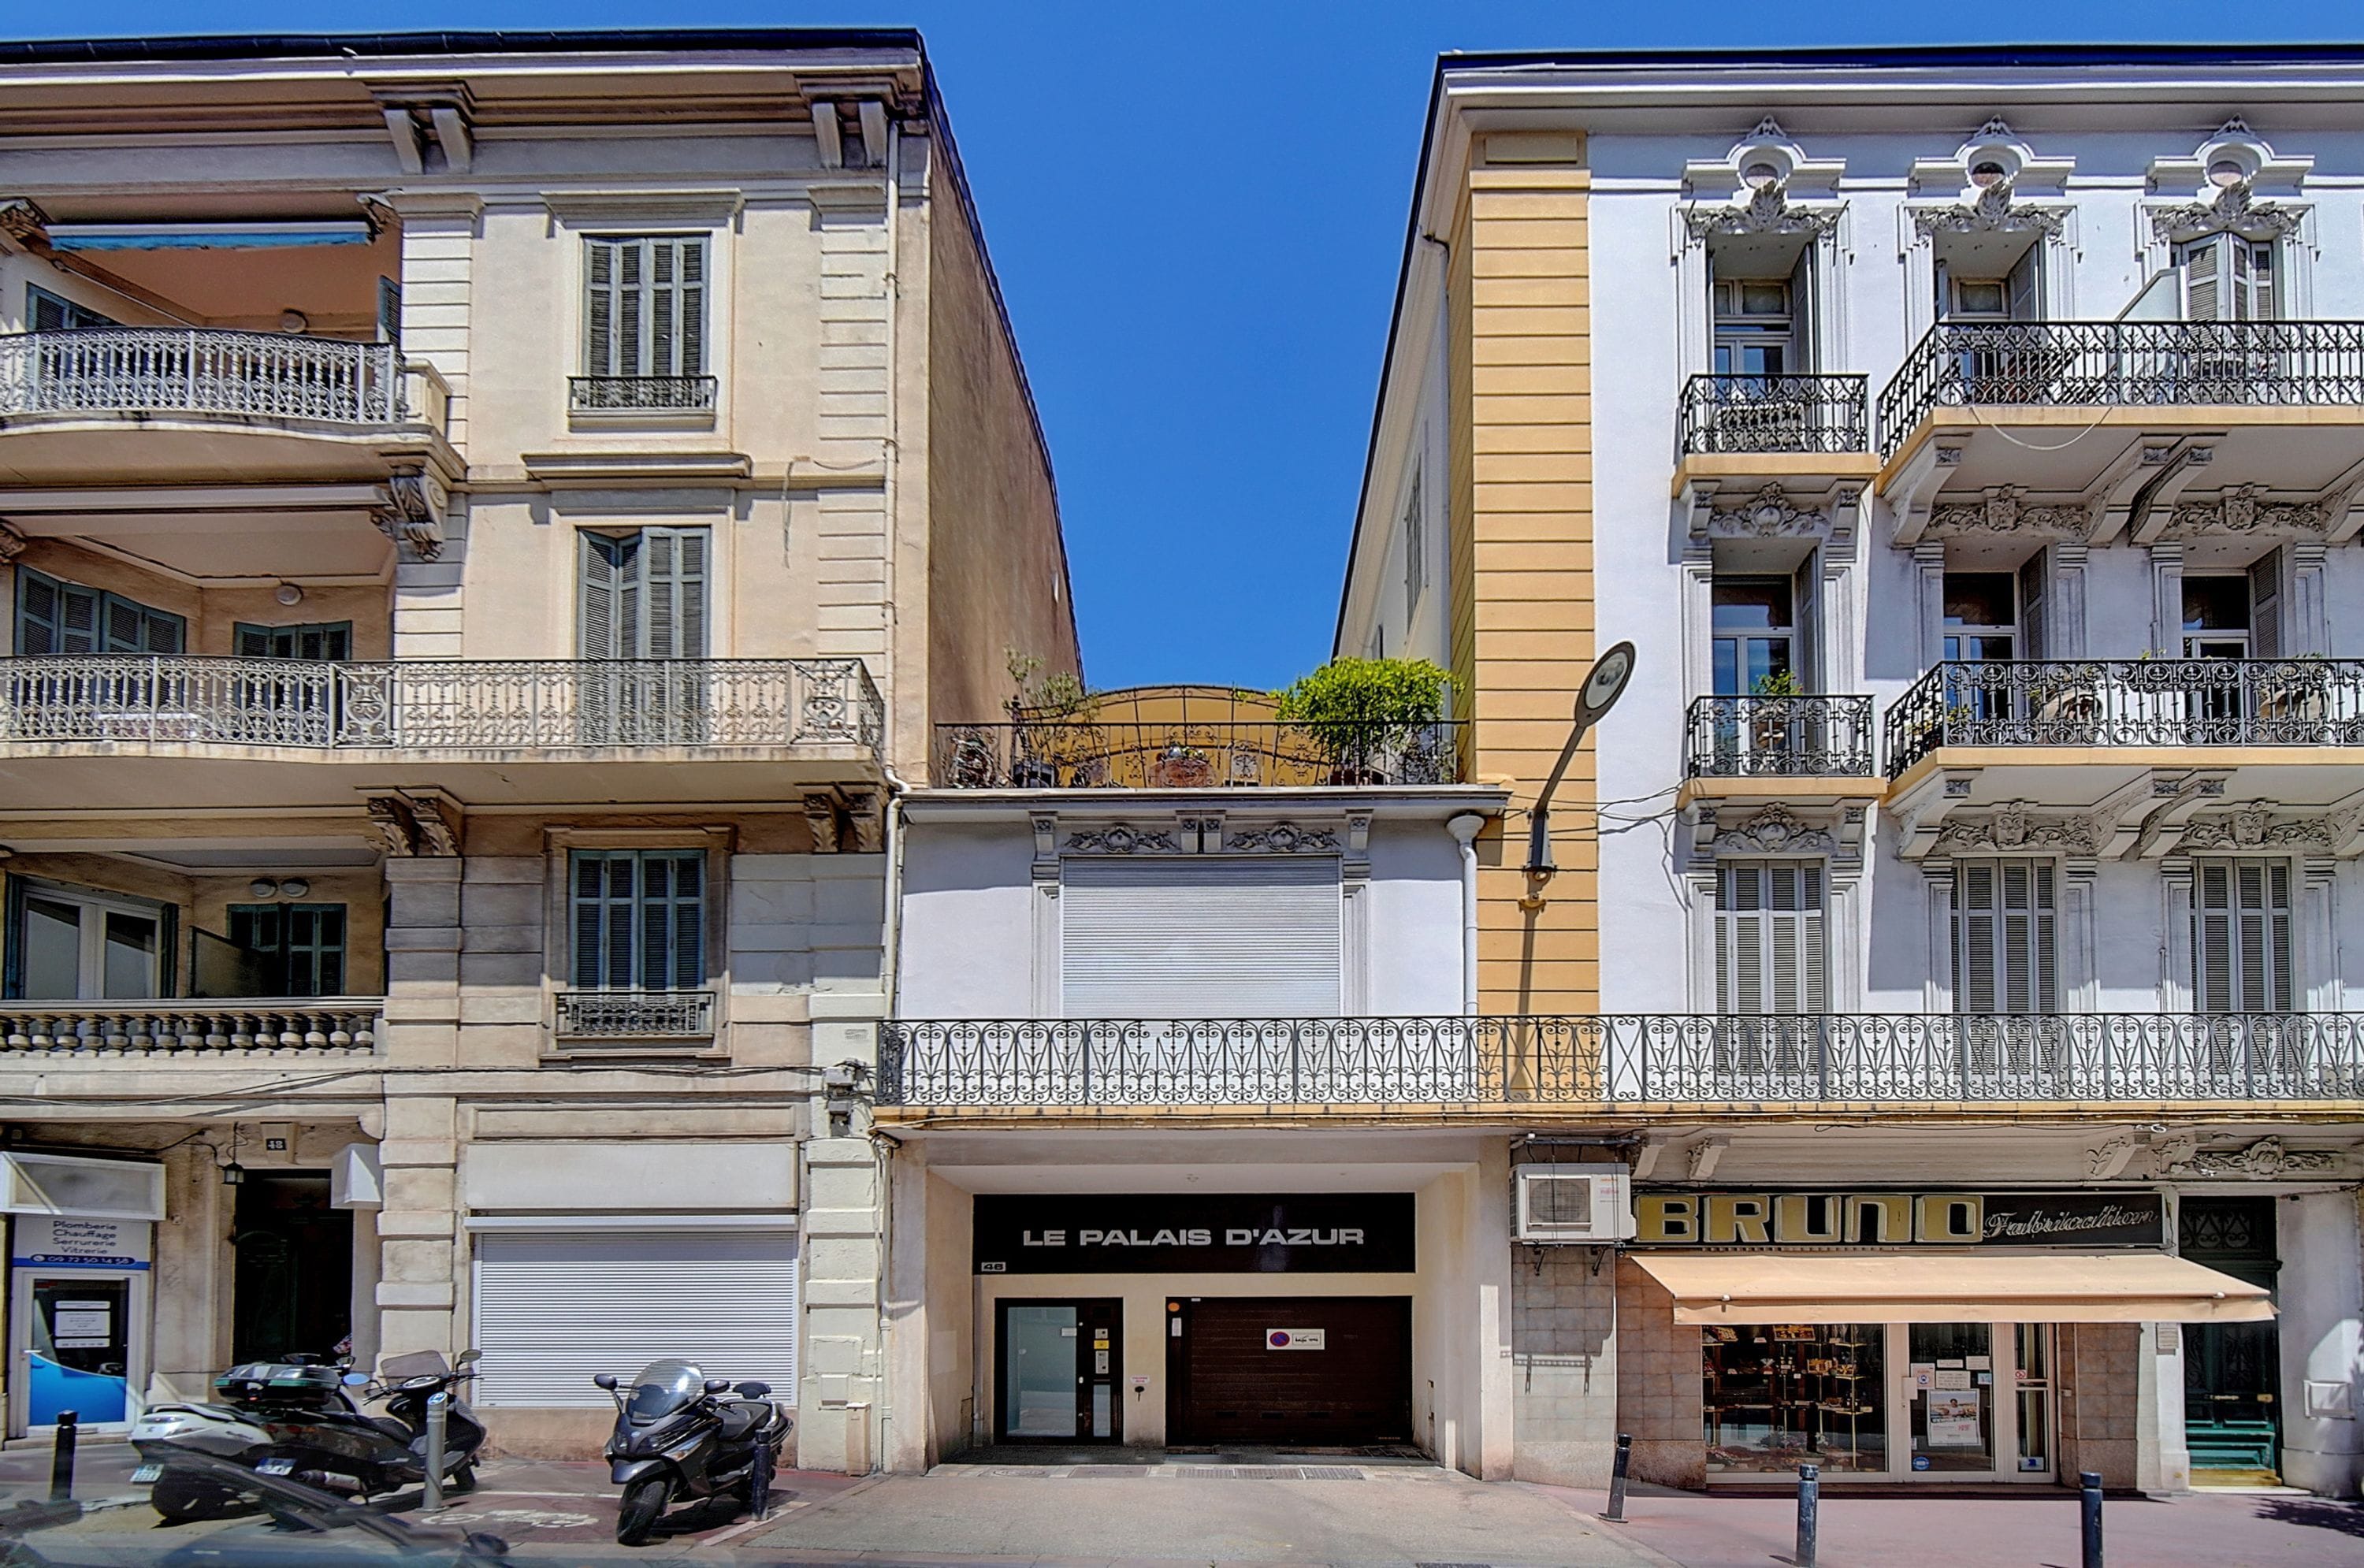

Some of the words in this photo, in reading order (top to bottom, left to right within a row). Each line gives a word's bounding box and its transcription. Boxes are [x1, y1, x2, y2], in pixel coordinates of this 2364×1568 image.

[268, 1140, 283, 1149] 48
[53, 1221, 117, 1230] Plomberie
[52, 1229, 117, 1239] Chauffage
[1023, 1230, 1066, 1246] LE
[1080, 1229, 1212, 1246] PALAIS
[1225, 1228, 1364, 1246] D'AZUR
[52, 1238, 117, 1247] Serrurerie
[61, 1246, 108, 1254] Vitrerie
